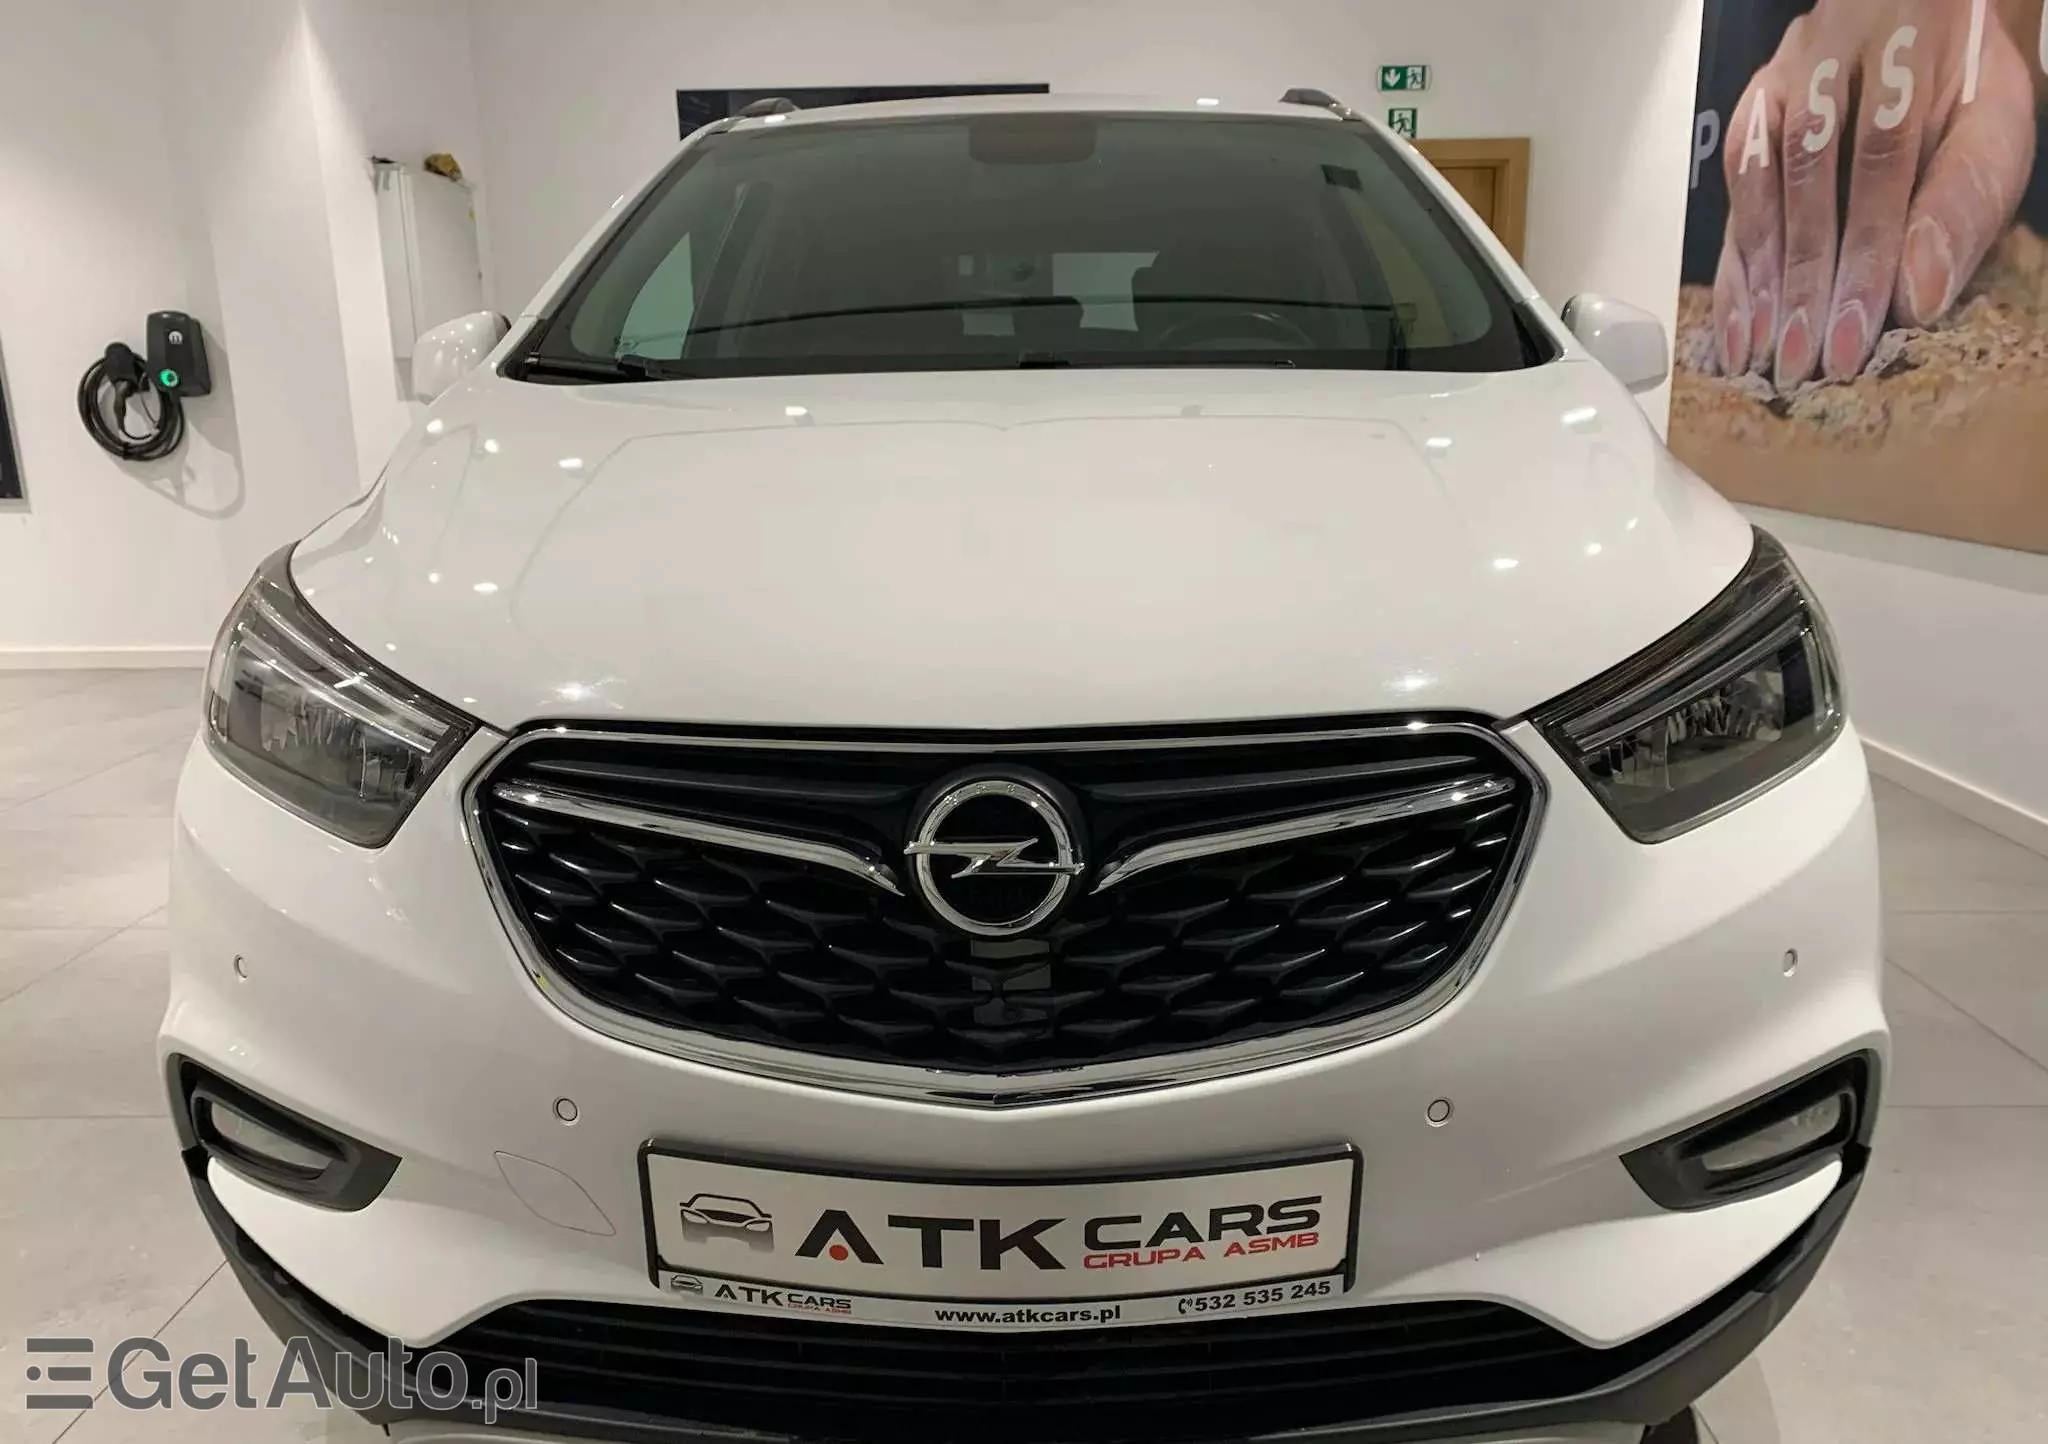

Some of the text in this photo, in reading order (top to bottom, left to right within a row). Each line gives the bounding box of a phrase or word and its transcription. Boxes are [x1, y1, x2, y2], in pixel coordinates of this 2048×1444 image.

[1690, 0, 2048, 189] PASSI
[794, 1195, 1322, 1270] ATK CARS
[1083, 1231, 1320, 1269] GRUPA ASMB
[714, 1283, 783, 1307] ATK
[787, 1293, 852, 1309] CARS
[1194, 1281, 1331, 1312] 532 535 245
[935, 1305, 1121, 1323] www.atkcars.pl
